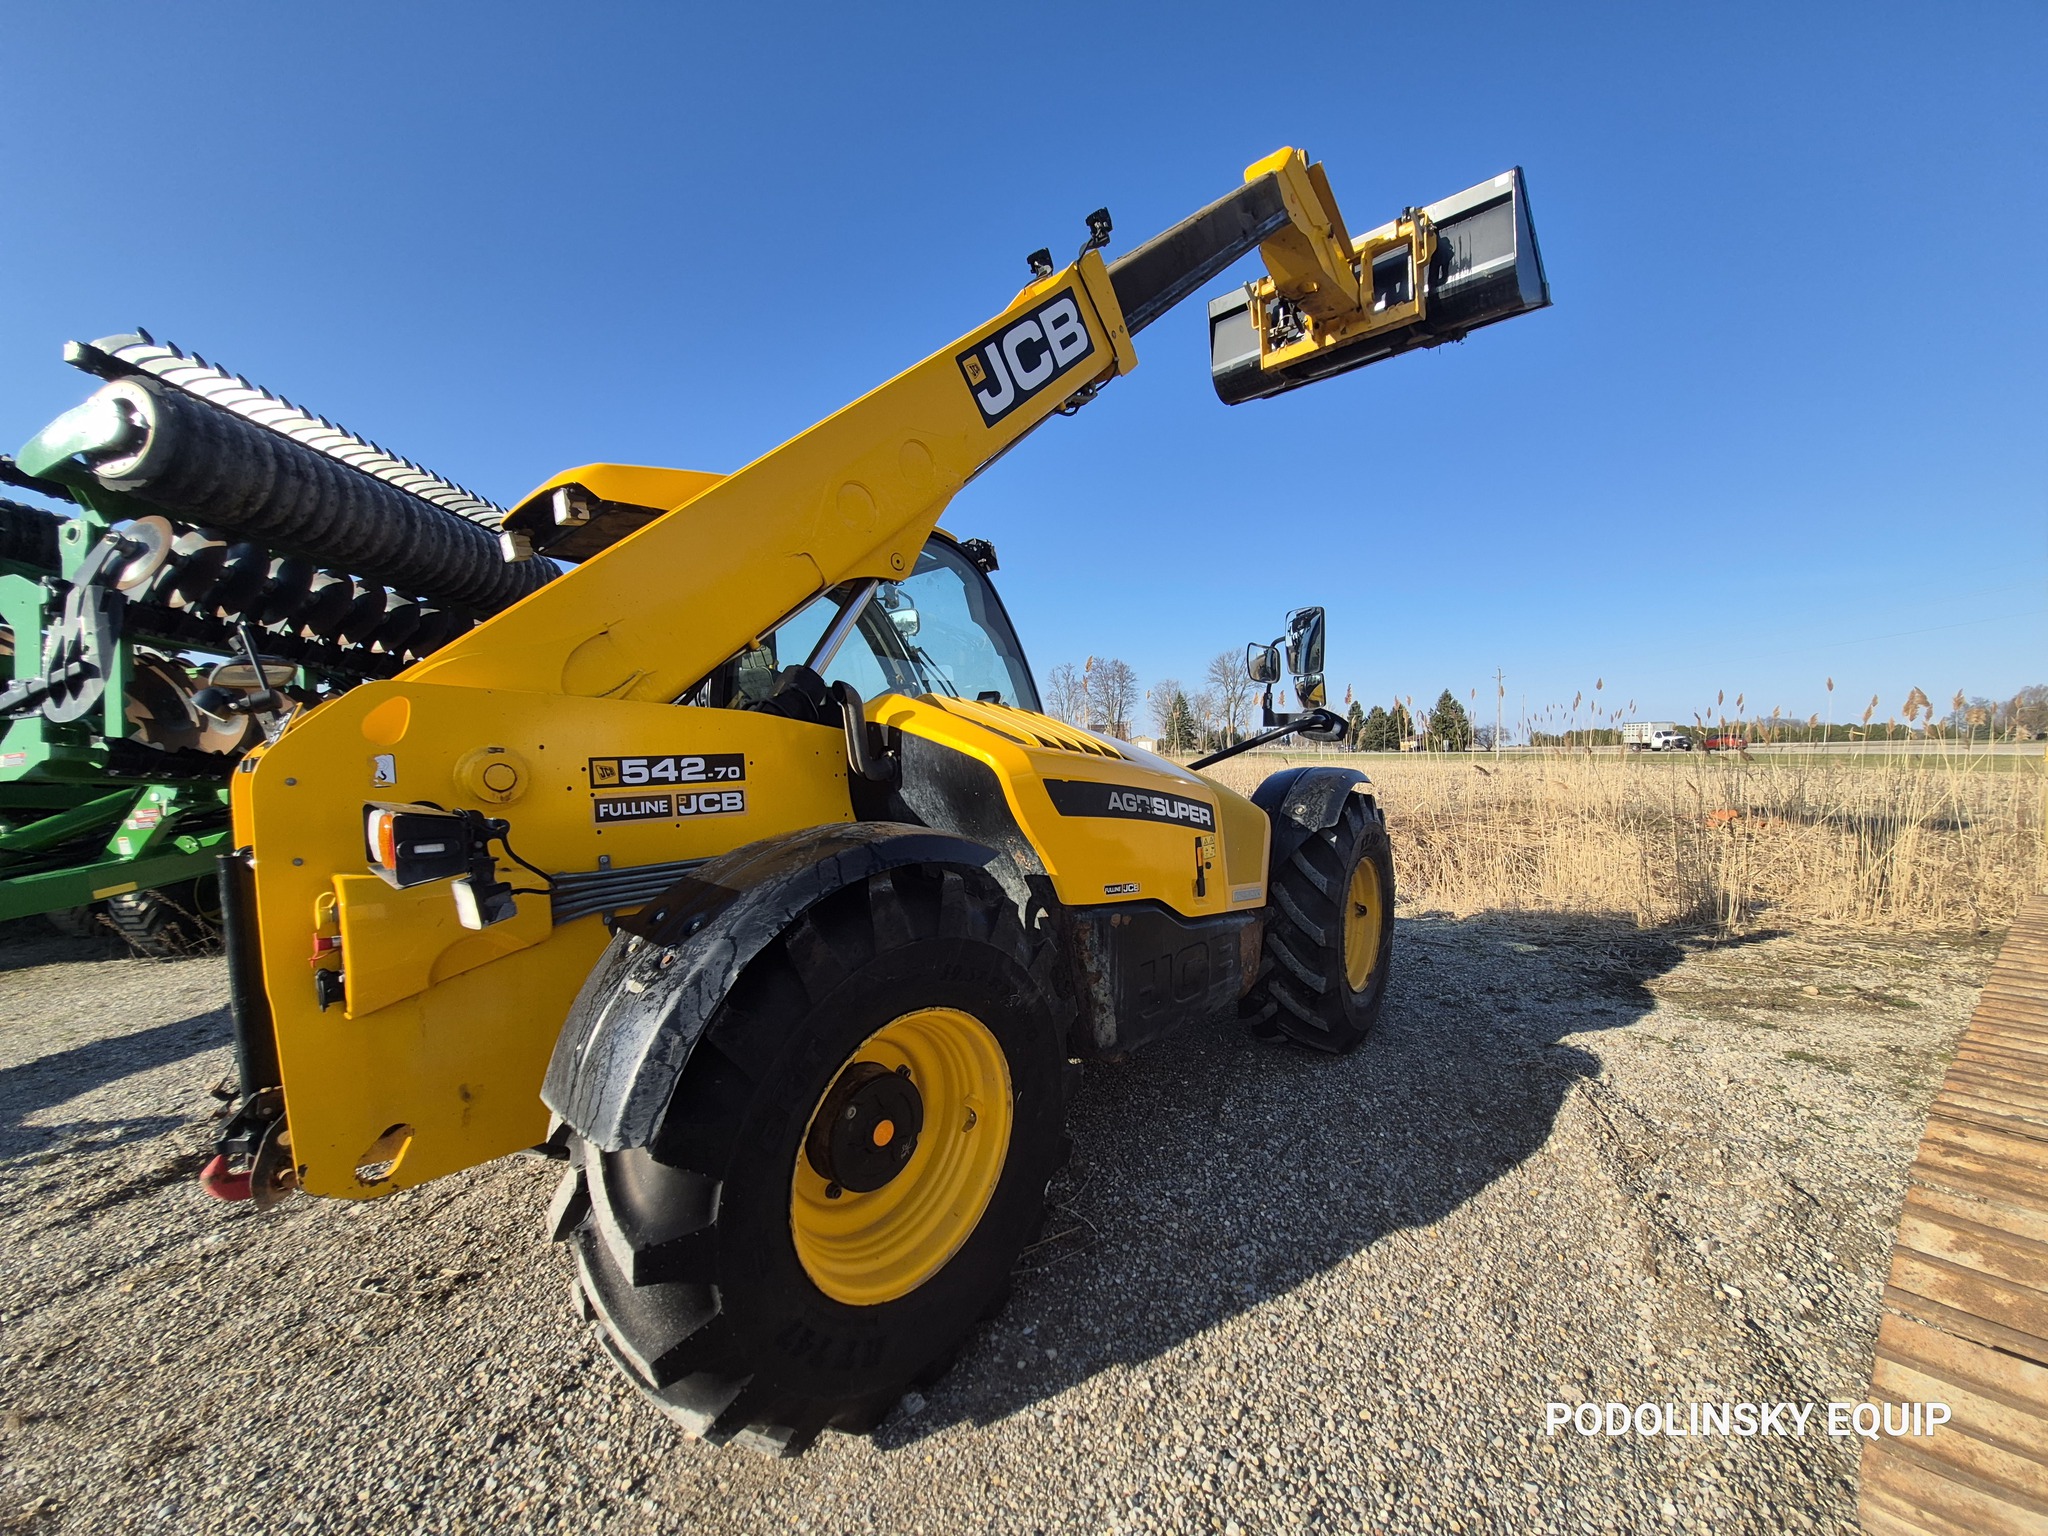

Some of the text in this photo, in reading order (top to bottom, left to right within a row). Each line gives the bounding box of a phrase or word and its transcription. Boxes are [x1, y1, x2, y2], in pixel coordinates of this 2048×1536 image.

[977, 298, 1089, 416] JCB
[599, 792, 743, 818] FULLINE JCB
